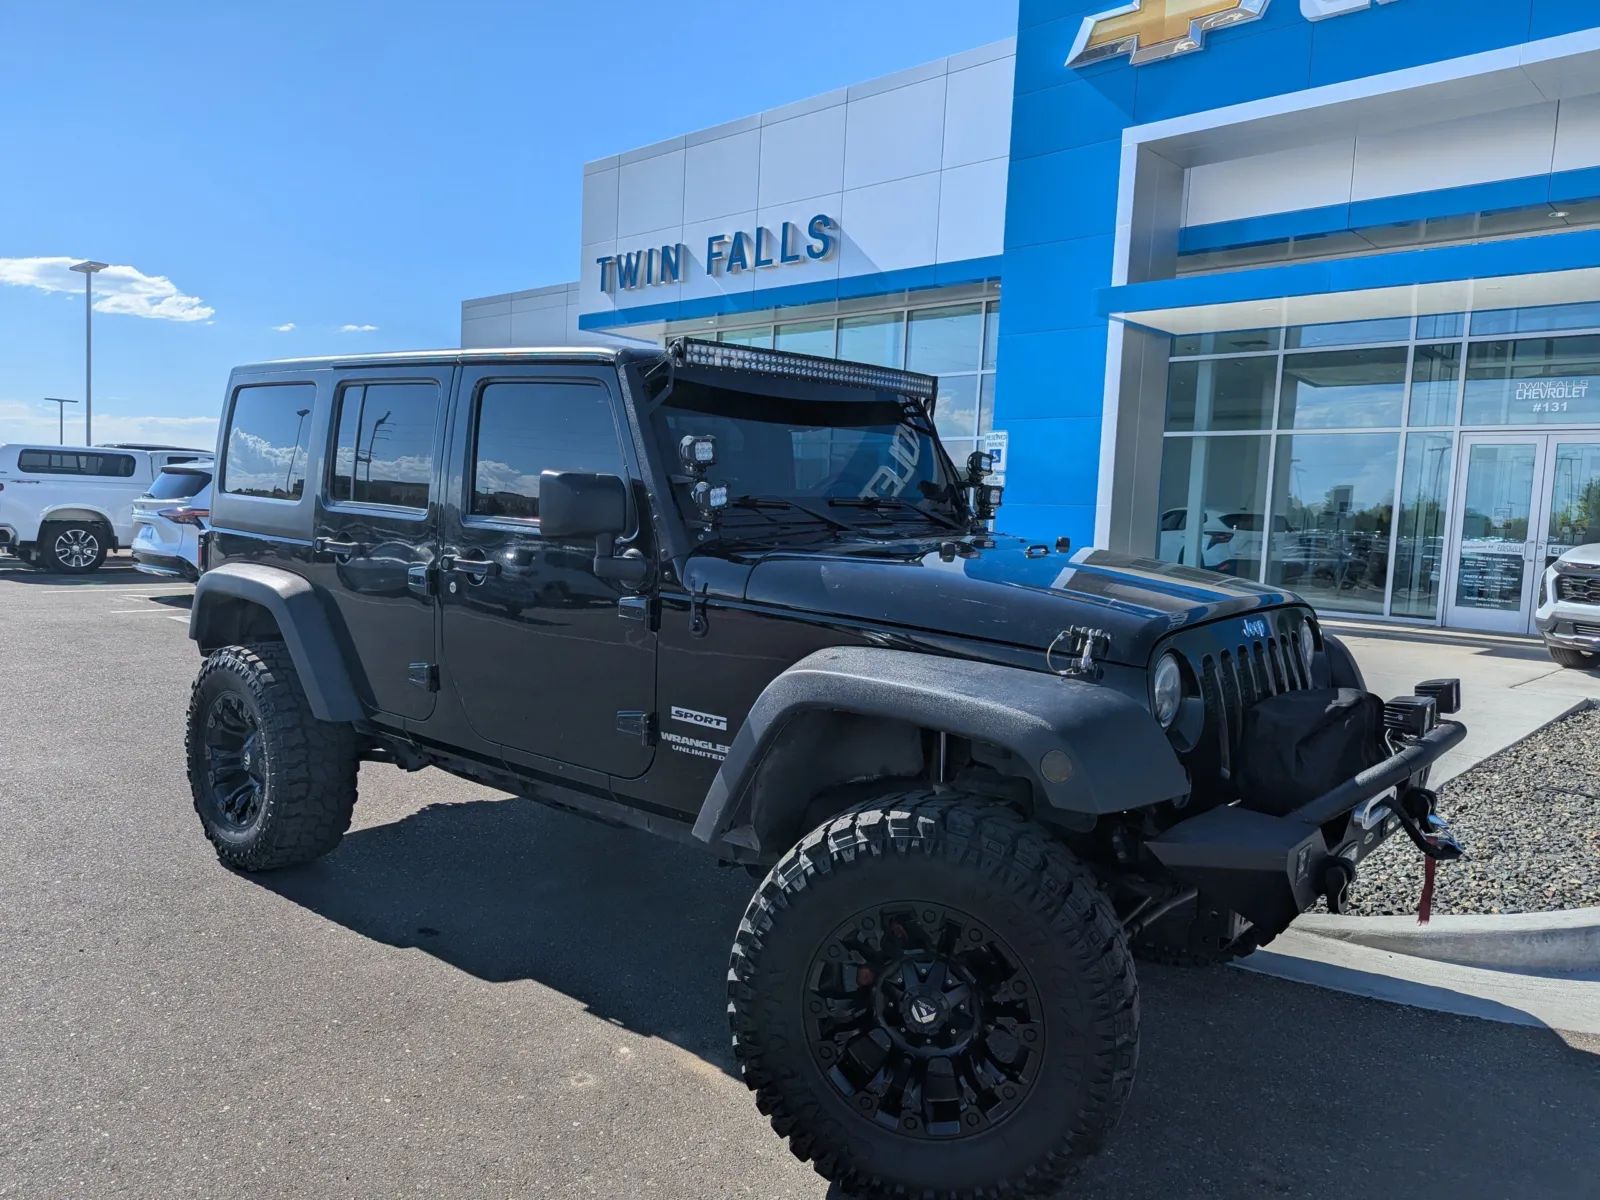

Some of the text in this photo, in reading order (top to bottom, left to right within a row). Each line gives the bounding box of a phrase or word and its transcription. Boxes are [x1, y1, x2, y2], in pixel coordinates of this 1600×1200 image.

[597, 214, 837, 293] TWIN FALLS
[1515, 387, 1588, 400] CHEVROLET
[1532, 401, 1568, 412] #131
[1242, 619, 1265, 637] Jeep
[671, 708, 727, 728] SPORT
[671, 744, 726, 761] UNLIMITED
